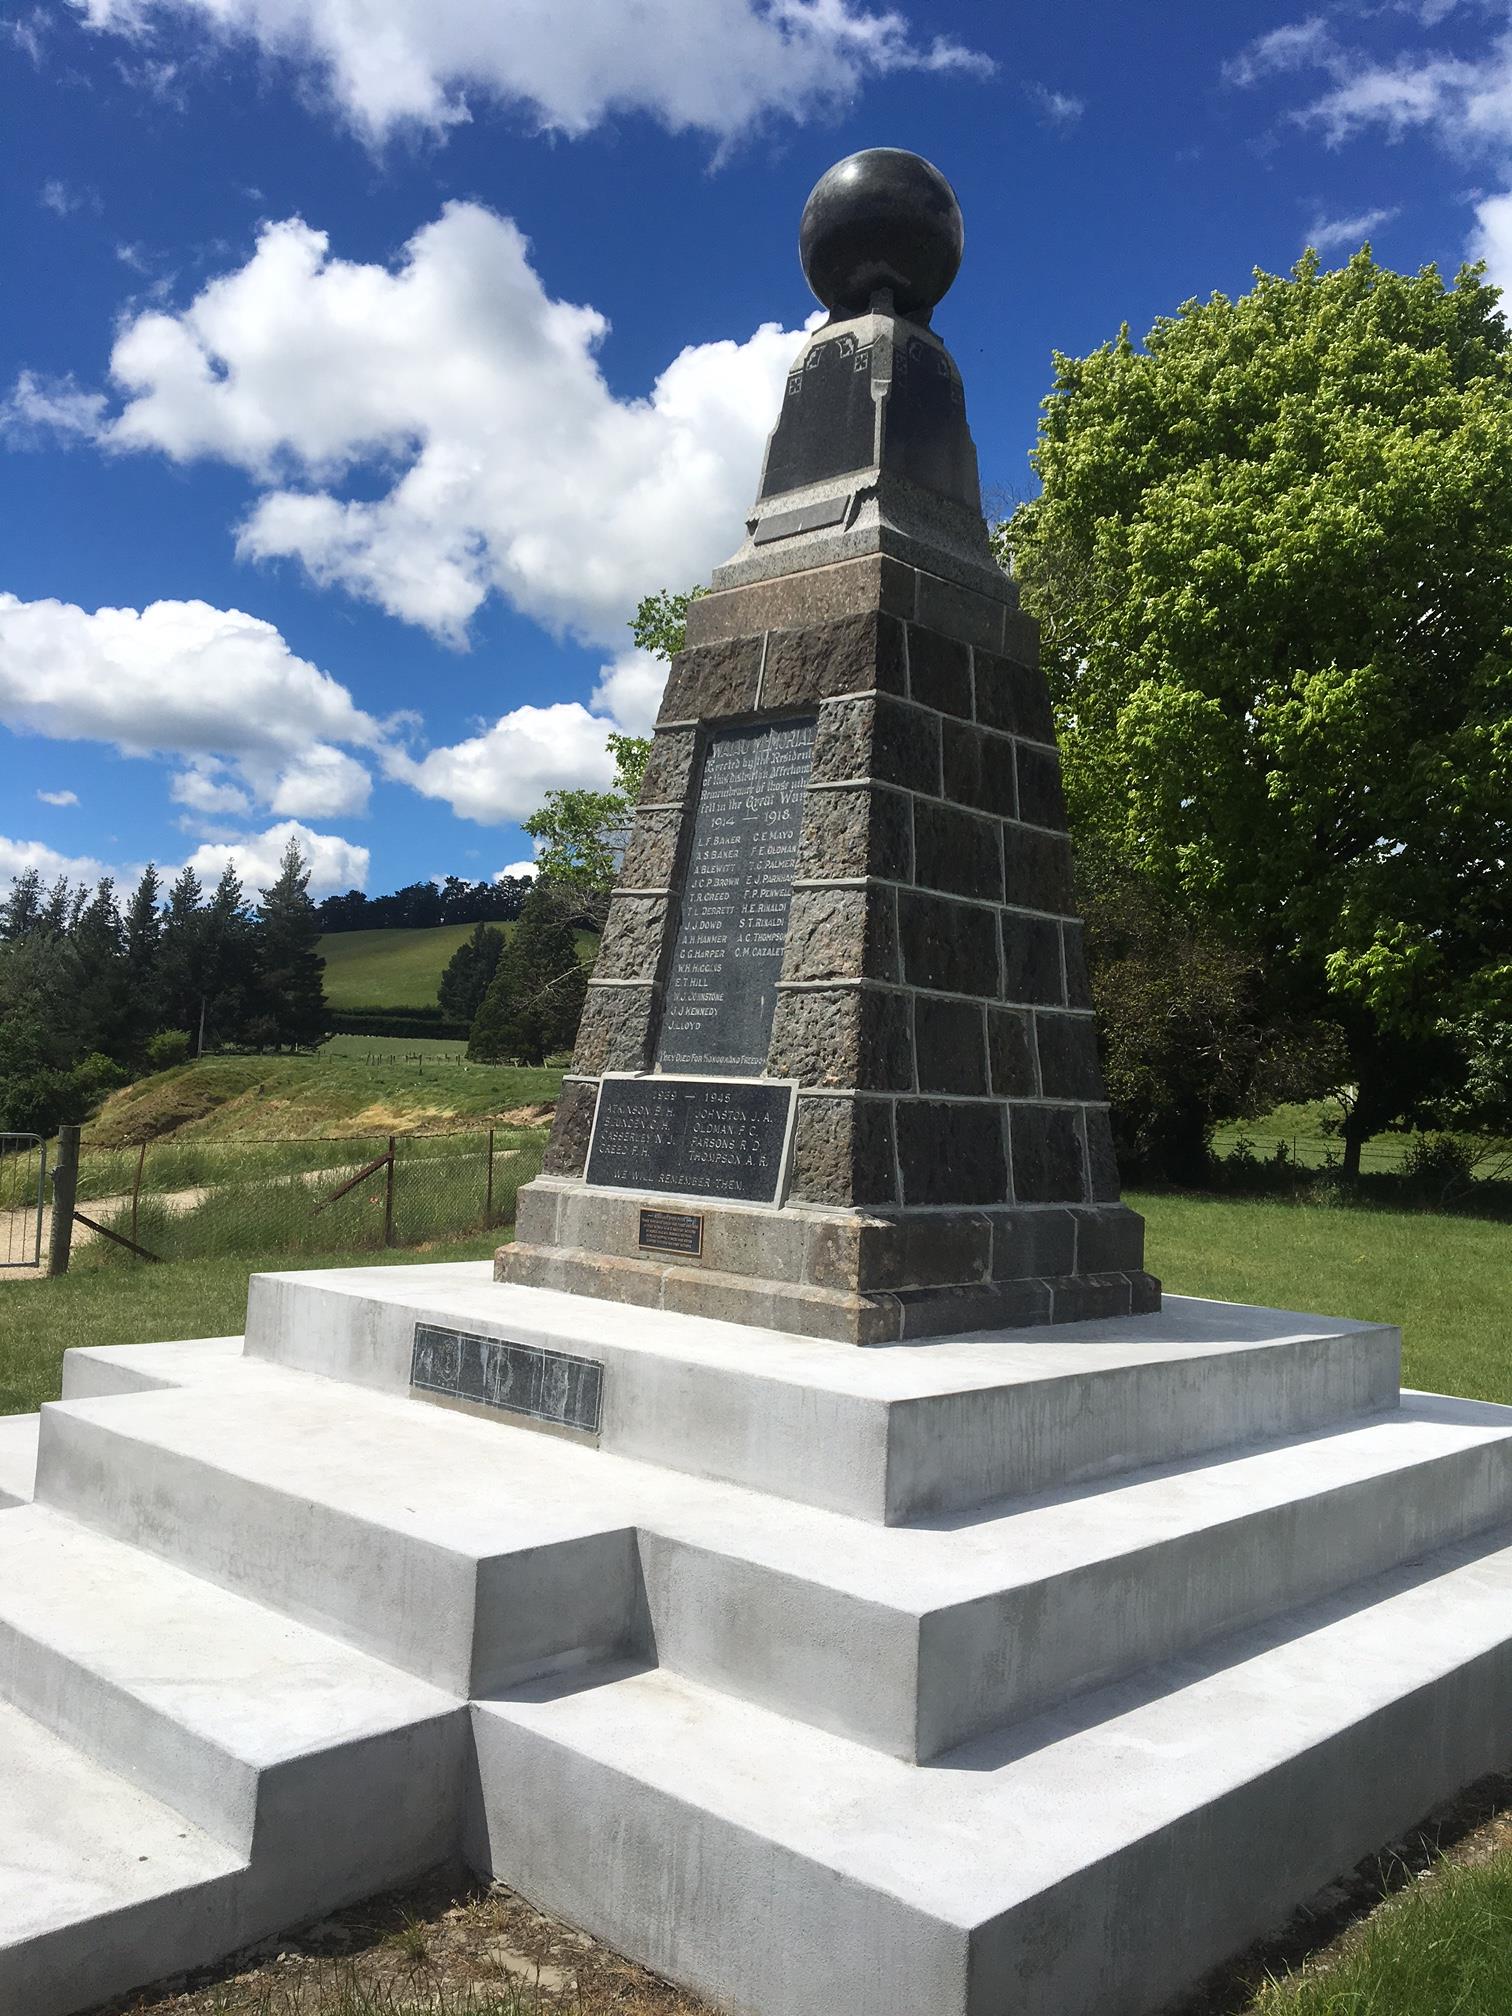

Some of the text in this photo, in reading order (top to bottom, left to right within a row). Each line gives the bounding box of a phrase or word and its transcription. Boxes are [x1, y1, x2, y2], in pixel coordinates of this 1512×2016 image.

[742, 757, 754, 770] by
[702, 776, 712, 787] of
[755, 781, 766, 794] of
[767, 780, 789, 792] those
[700, 790, 807, 814] fell in the Great War
[711, 816, 735, 831] 1914
[769, 830, 793, 840] MAYO
[713, 836, 741, 846] BAKER
[711, 849, 739, 860] BAKER
[767, 845, 796, 855] OLDMAN
[764, 859, 795, 870] PALMER
[713, 878, 740, 887] BROWN
[760, 888, 791, 898] PENWELL
[701, 906, 735, 915] DERRETT
[757, 903, 787, 913] RINALDI
[699, 920, 722, 930] DOWD
[755, 918, 784, 927] RINALDI
[696, 935, 728, 944] HANMER
[695, 949, 726, 958] HARPER
[692, 963, 722, 973] HIGGINS
[689, 977, 708, 987] HILL
[685, 1007, 719, 1016] KENNEDY
[691, 1053, 703, 1063] FOR
[705, 1092, 731, 1103] 1945
[695, 1109, 747, 1122] JOHNSTON
[693, 1122, 733, 1135] OLDMAN
[690, 1136, 736, 1150] PARSONS
[688, 1150, 741, 1164] THOMPSON
[658, 1172, 711, 1188] REMEMBER
